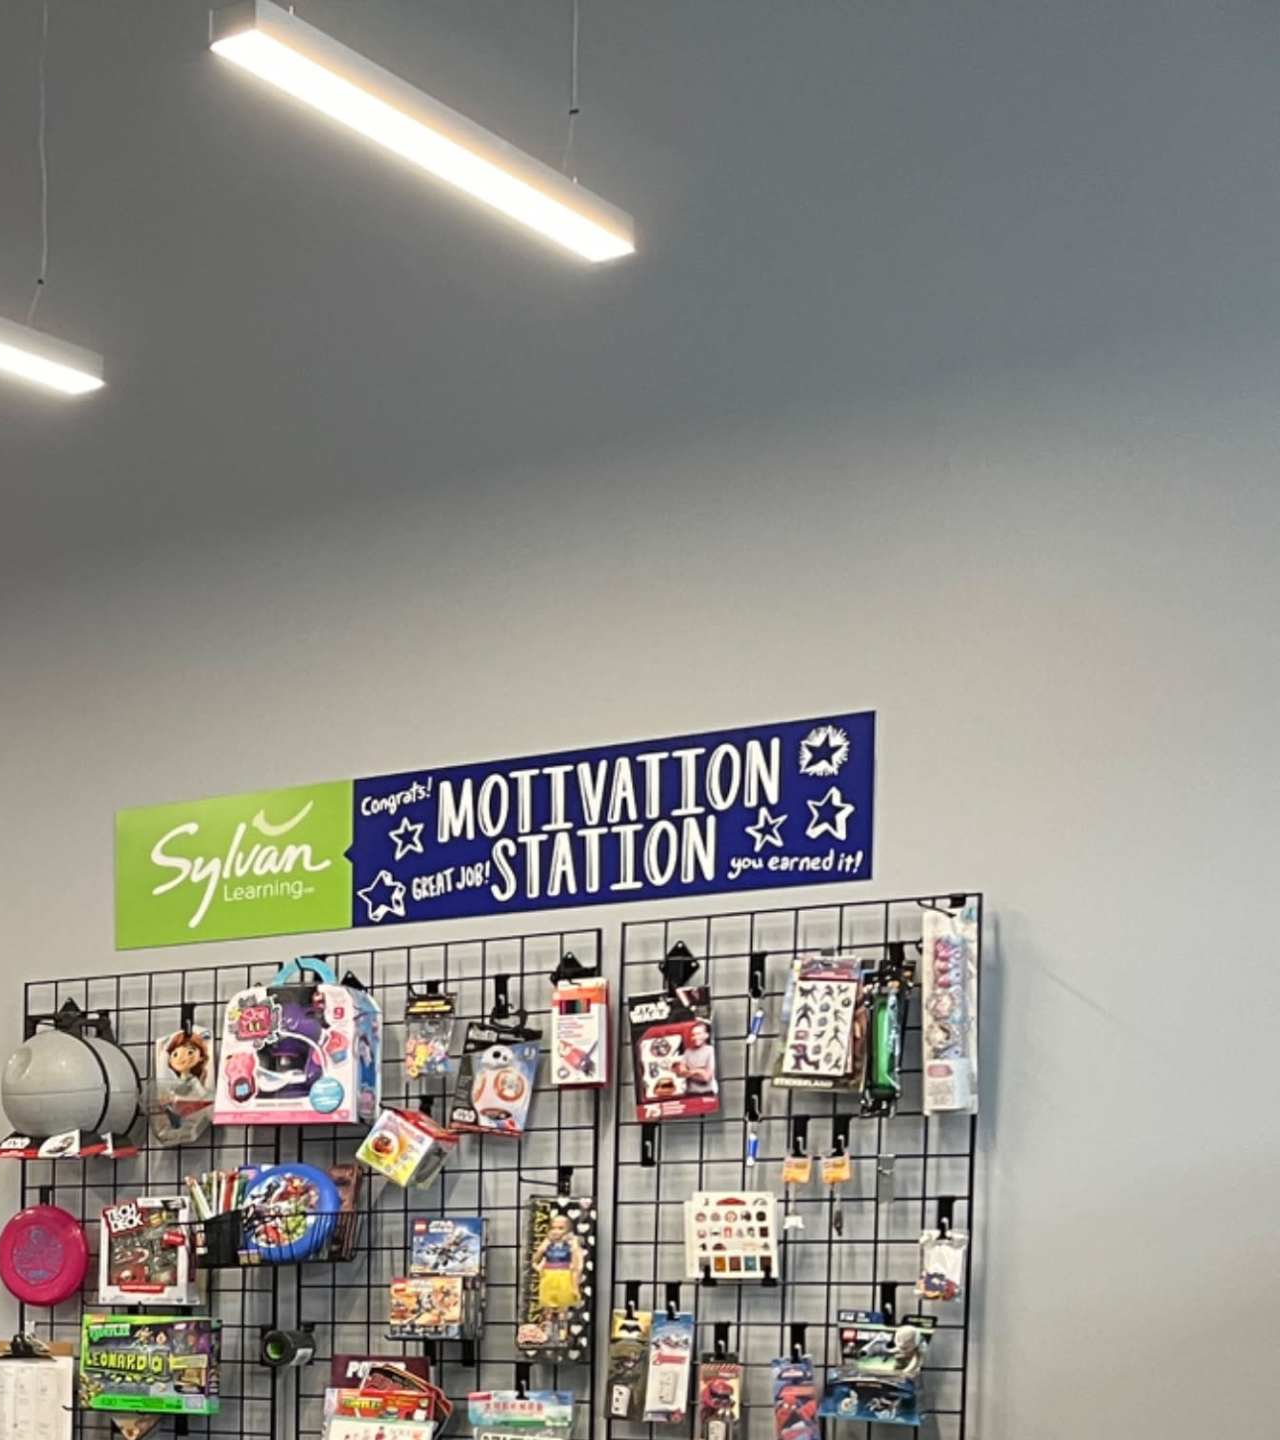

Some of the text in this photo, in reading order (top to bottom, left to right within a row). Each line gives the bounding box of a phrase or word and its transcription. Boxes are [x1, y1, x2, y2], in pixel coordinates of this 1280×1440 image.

[361, 776, 433, 816] Congrats!
[437, 737, 781, 844] MOTIVATION
[150, 821, 332, 929] Sylvan
[491, 814, 717, 901] STATION
[727, 848, 864, 880] you earned it!
[223, 880, 304, 902] Learning
[411, 860, 491, 901] GREAT JOB!
